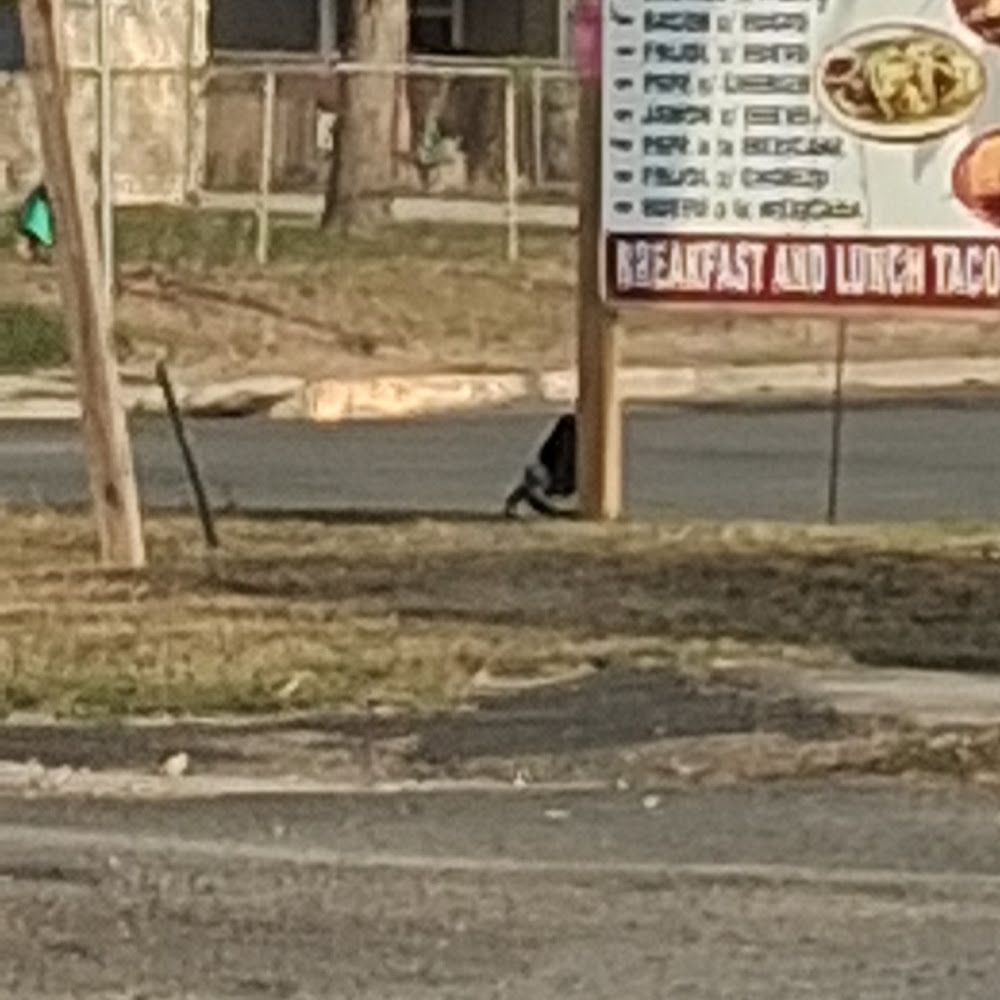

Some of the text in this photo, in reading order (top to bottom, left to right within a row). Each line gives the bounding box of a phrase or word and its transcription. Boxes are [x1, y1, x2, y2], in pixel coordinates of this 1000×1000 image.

[616, 239, 767, 292] BREAKFAST
[772, 242, 826, 295] AND
[835, 244, 926, 296] LUNCH
